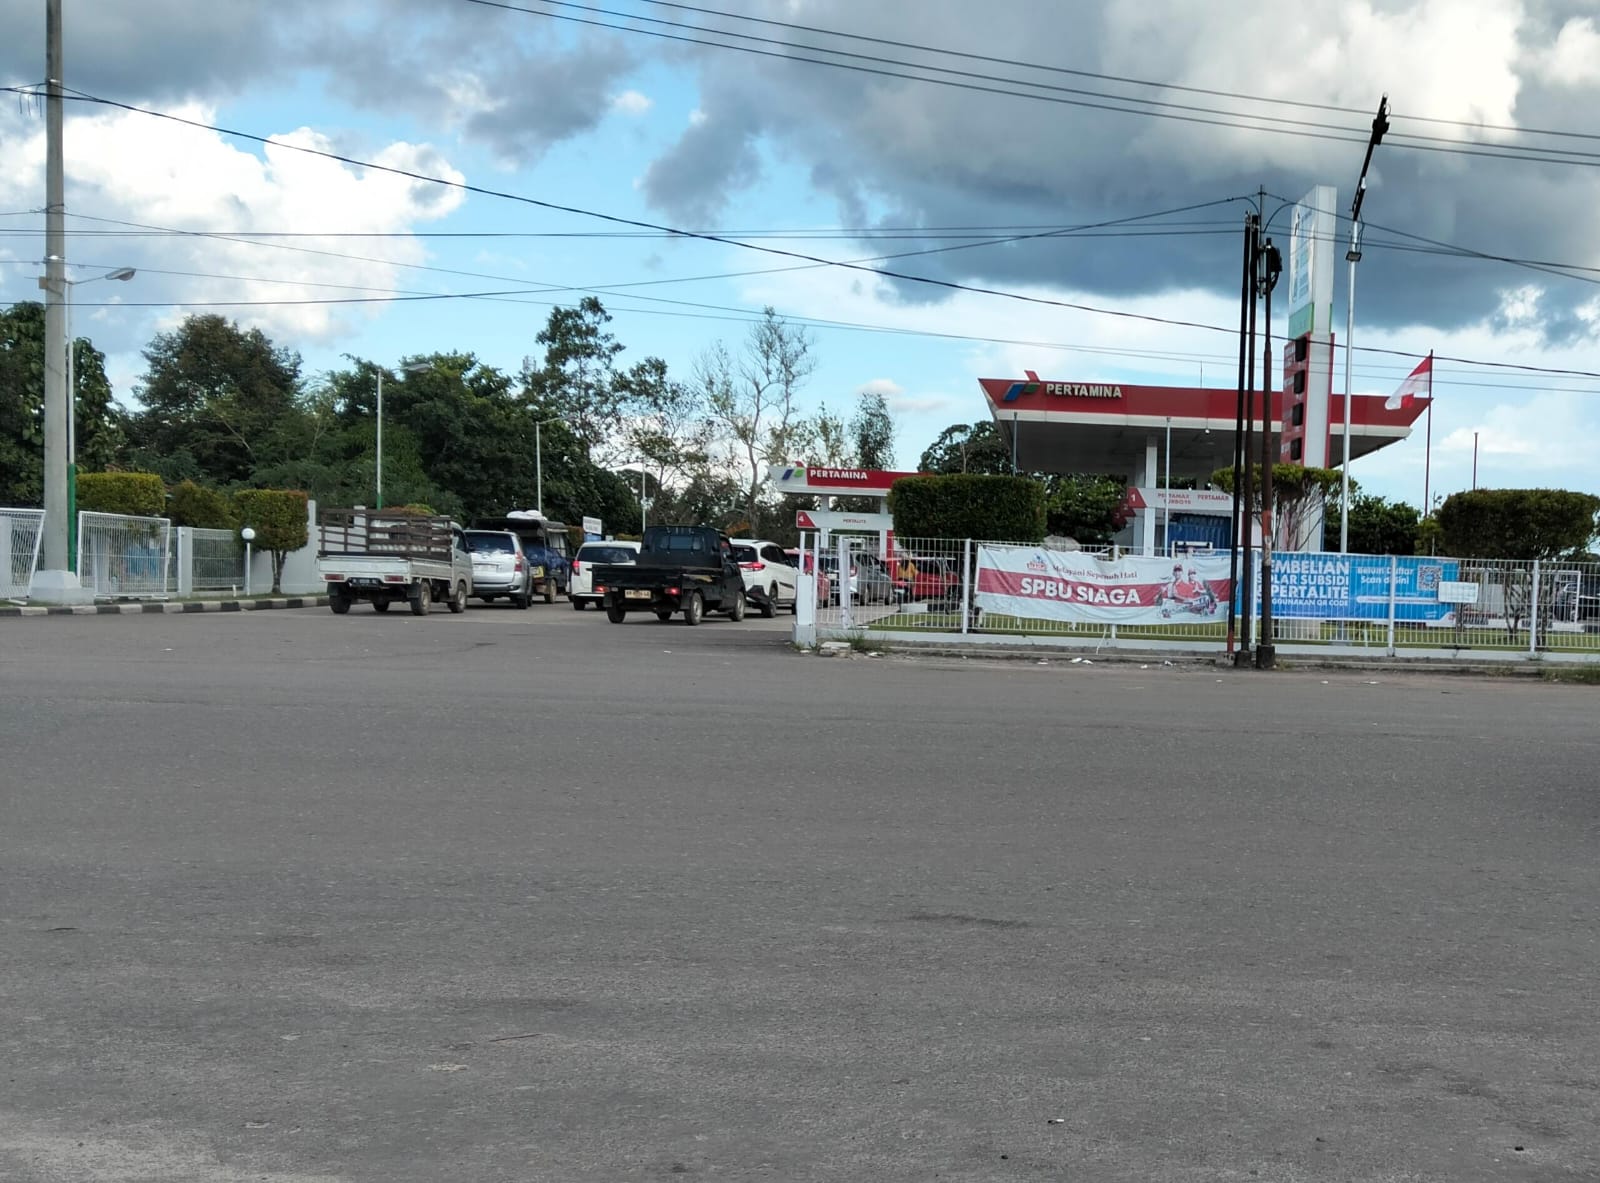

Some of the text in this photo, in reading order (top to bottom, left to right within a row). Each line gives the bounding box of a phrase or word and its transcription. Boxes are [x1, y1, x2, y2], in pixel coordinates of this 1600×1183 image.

[1046, 383, 1122, 398] PERTAMINA
[810, 469, 868, 480] PERTAMINA
[1131, 493, 1136, 502] 1
[1257, 572, 1349, 586] SLAR SUBSIDI
[1360, 575, 1382, 584] Scan
[1020, 577, 1142, 605] SPBU SIAGA
[1271, 584, 1349, 599] PERTALITE
[1328, 599, 1349, 607] CODE
